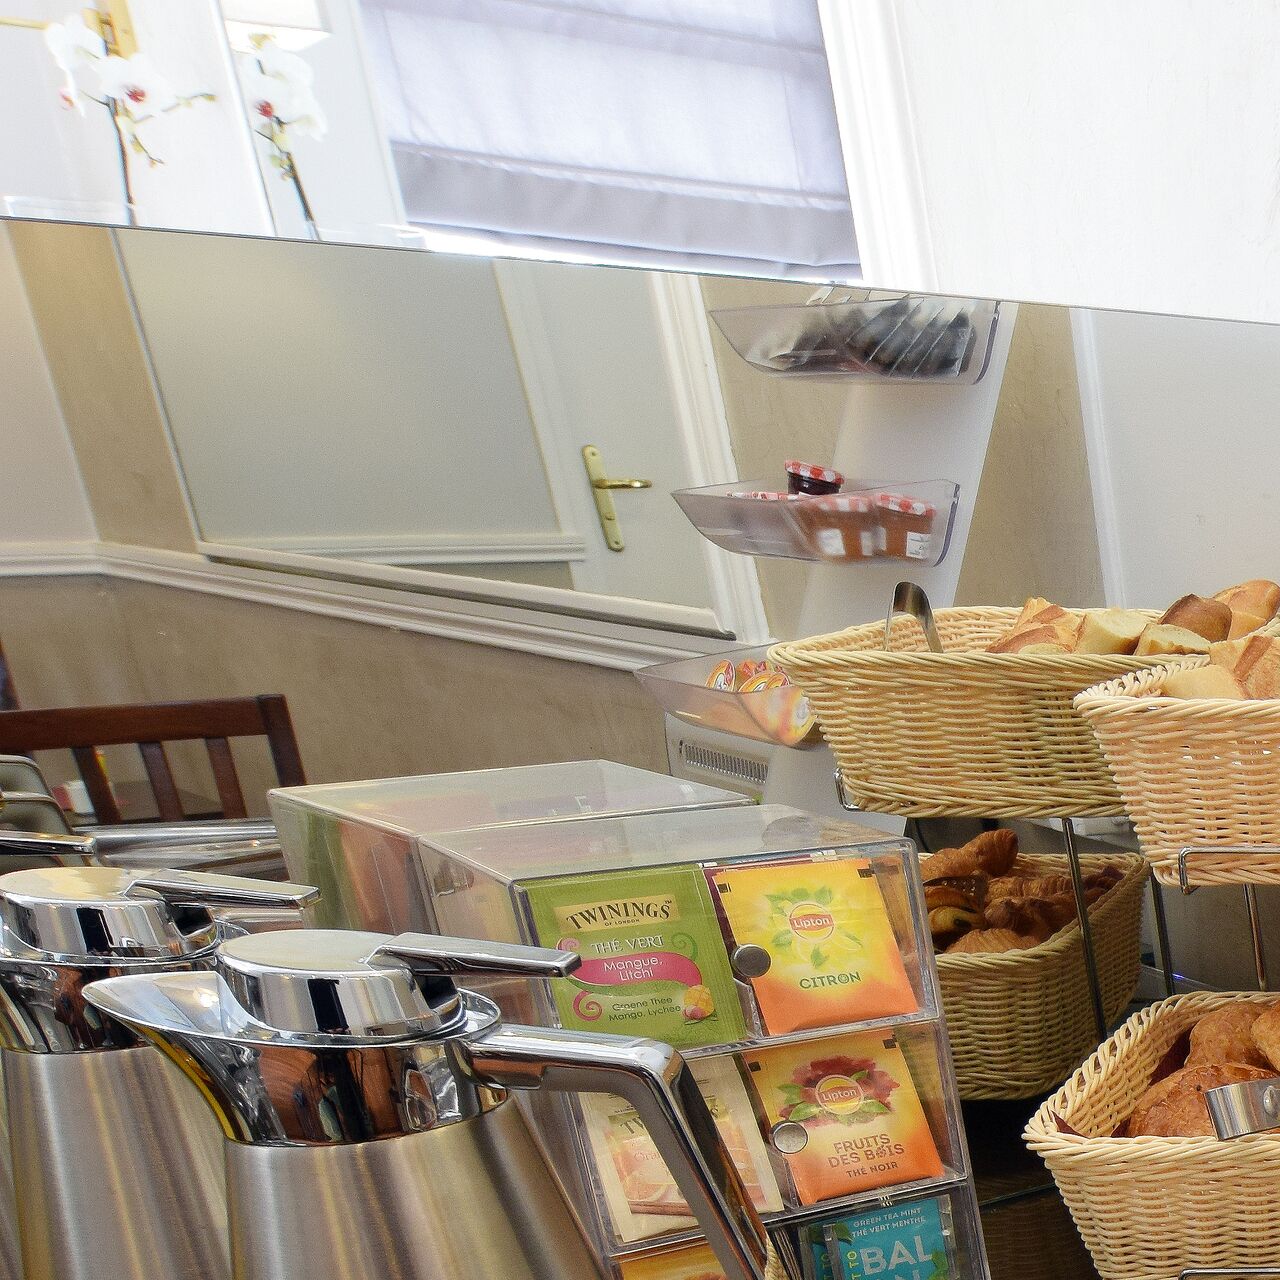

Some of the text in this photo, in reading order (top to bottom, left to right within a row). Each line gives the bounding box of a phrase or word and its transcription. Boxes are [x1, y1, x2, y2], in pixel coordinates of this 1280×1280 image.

[566, 901, 671, 930] TWININGS
[614, 918, 640, 926] LONDON
[793, 916, 830, 930] Lipton
[591, 935, 664, 954] THÉ VERT
[603, 956, 663, 972] Mangue,
[618, 967, 654, 982] Litchi
[799, 971, 862, 989] CITRON
[648, 1005, 682, 1018] Lychee
[821, 1088, 857, 1103] Lipton
[833, 1133, 891, 1154] FRUITS
[827, 1144, 905, 1168] DES BOIS
[869, 1161, 899, 1173] NOIR
[853, 1207, 922, 1228] GREEN TEA MINT
[869, 1223, 891, 1234] VERT
[891, 1216, 927, 1231] MENTHE
[846, 1250, 860, 1269] TO
[859, 1235, 933, 1276] BAL
